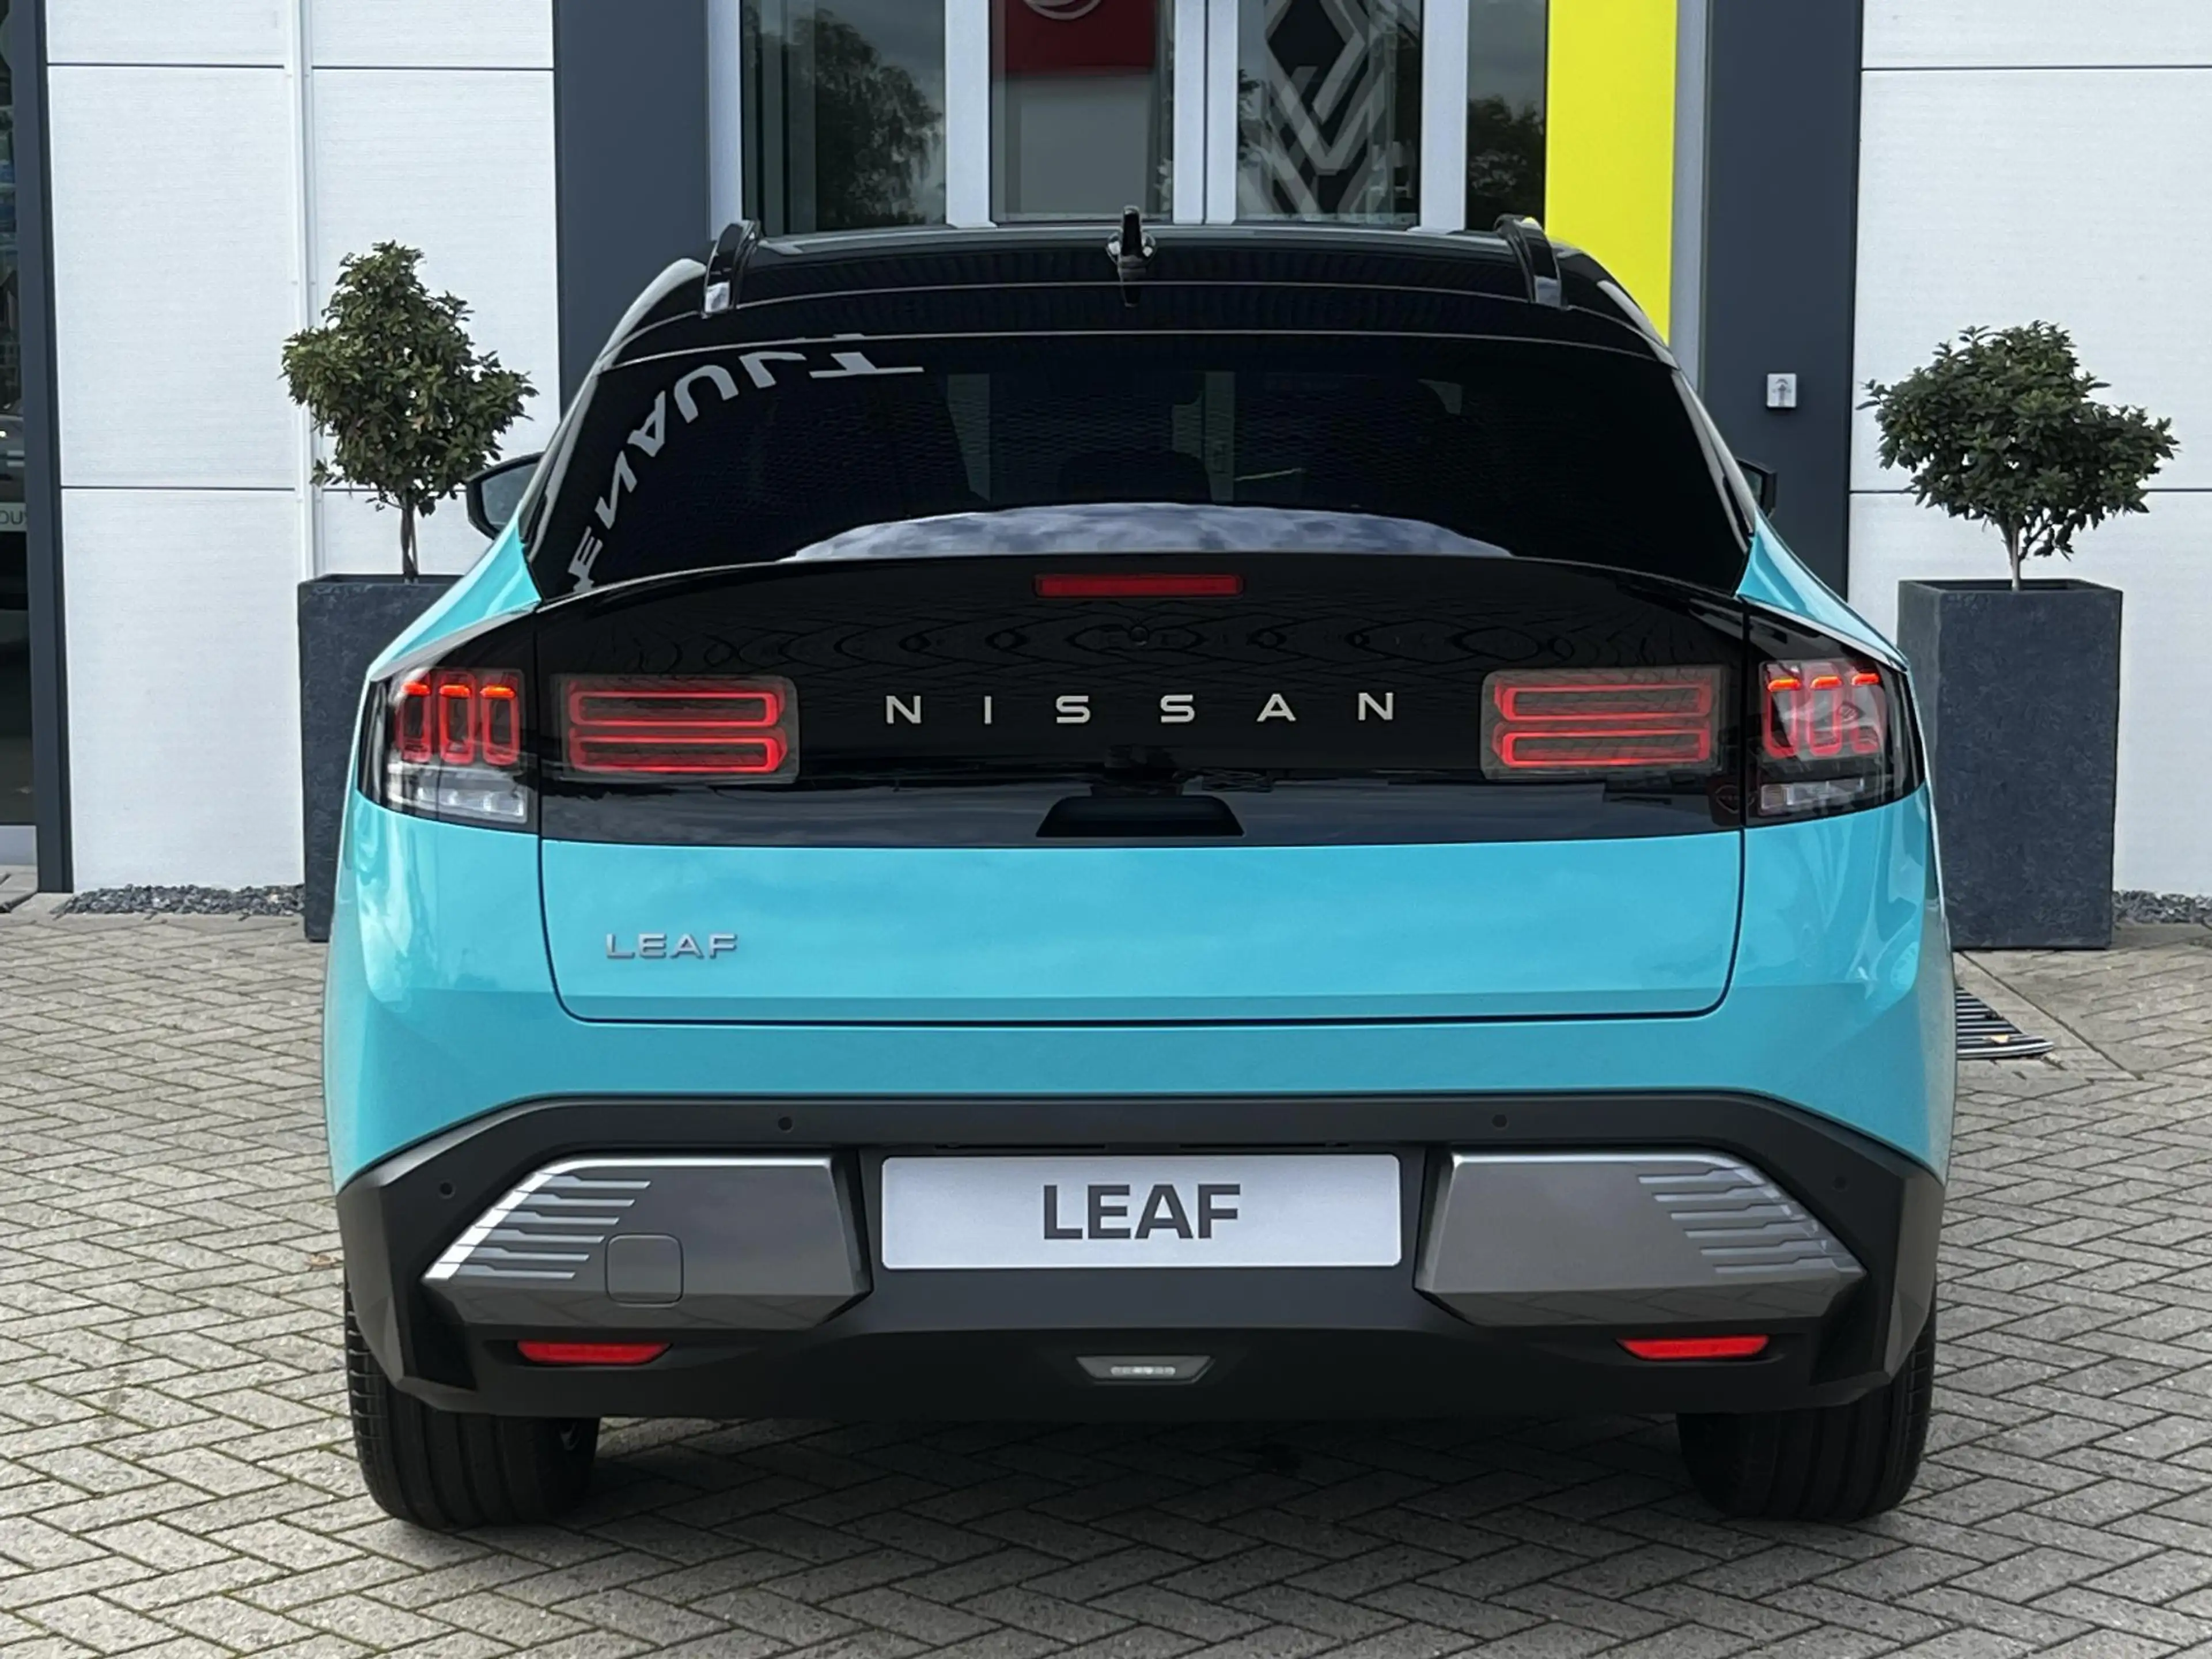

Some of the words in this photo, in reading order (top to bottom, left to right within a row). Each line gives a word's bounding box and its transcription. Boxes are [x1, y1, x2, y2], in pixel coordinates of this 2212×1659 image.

[886, 692, 1394, 724] NISSAN
[605, 933, 737, 959] LEAF
[1043, 1184, 1241, 1240] LEAF
